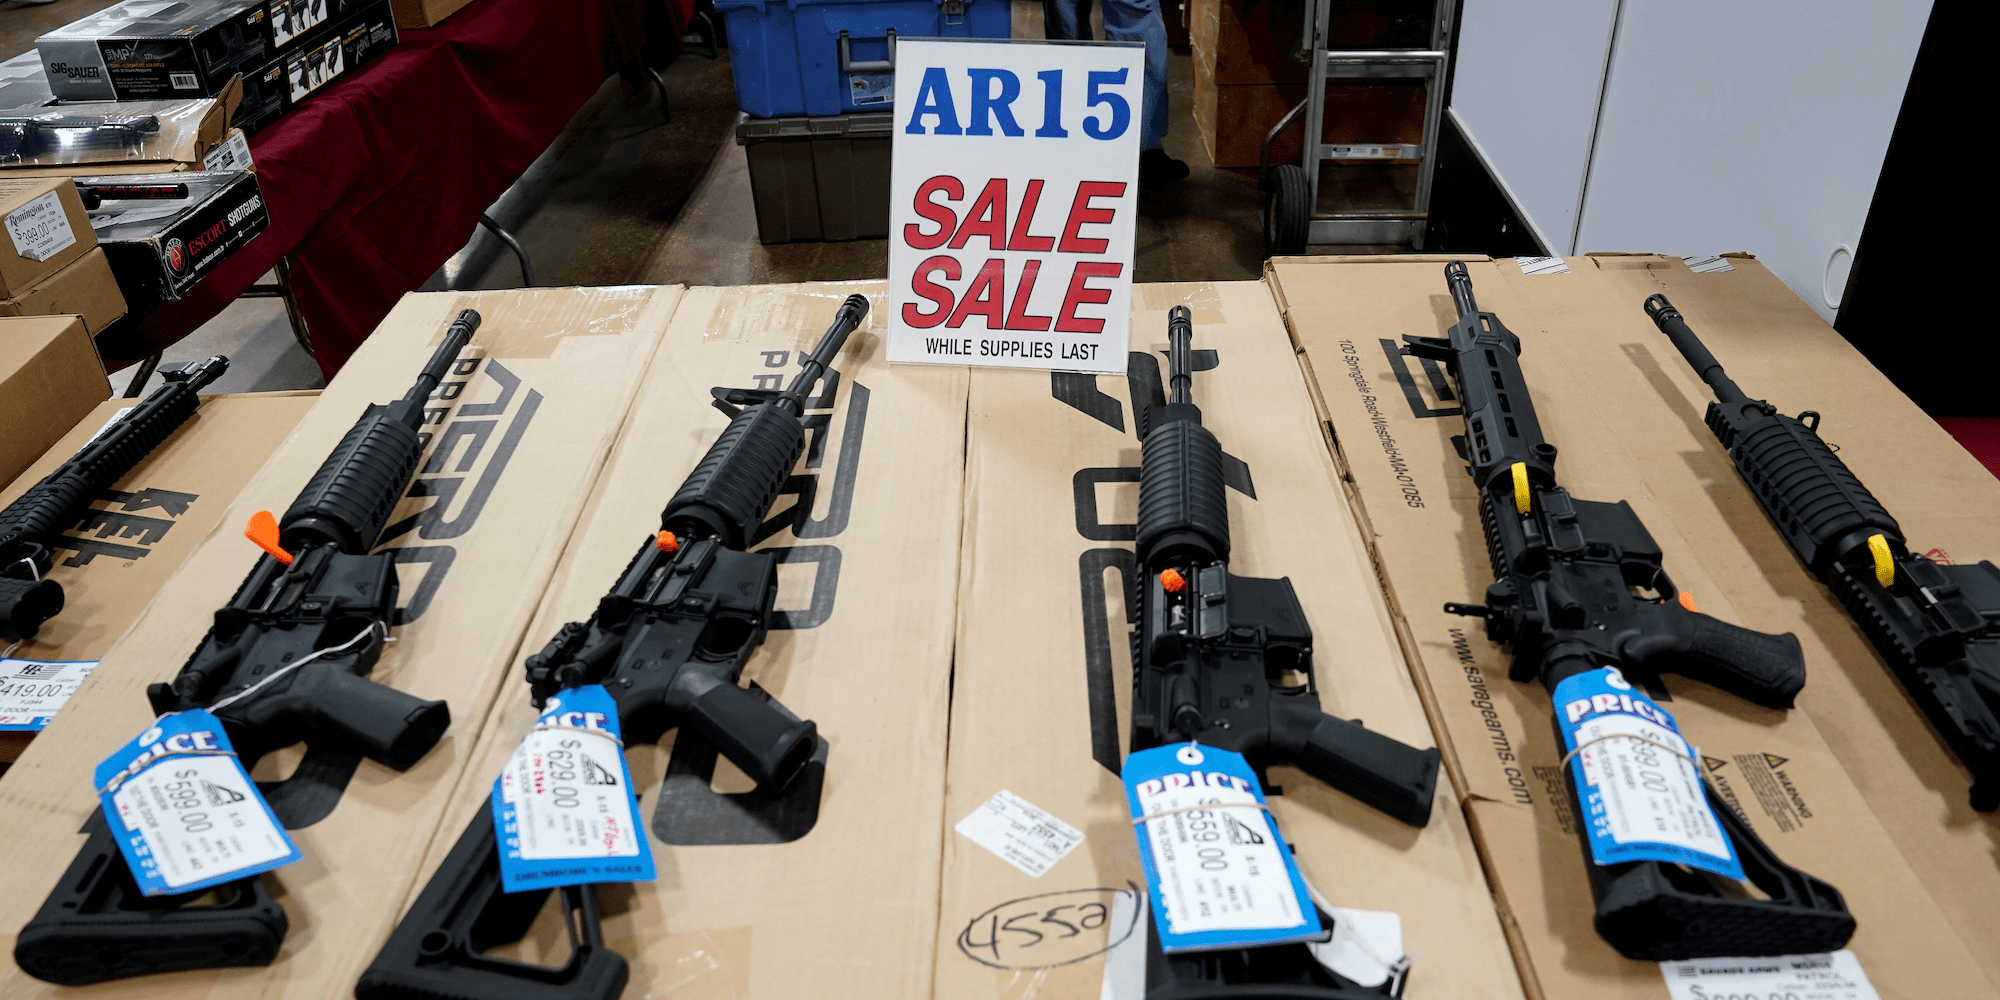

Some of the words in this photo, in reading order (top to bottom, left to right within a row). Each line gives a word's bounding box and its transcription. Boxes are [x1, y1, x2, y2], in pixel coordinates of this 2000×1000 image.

[51, 63, 67, 74] SIG
[68, 67, 99, 78] SAUER
[905, 67, 1131, 140] AR15
[10, 203, 45, 228] Remington
[188, 218, 227, 256] ESCORT
[226, 194, 261, 228] SHOTGUNS
[903, 175, 1127, 254] SALE
[901, 255, 1123, 334] SALE
[926, 338, 972, 356] WHILE
[980, 340, 1053, 358] SUPPLIES
[1061, 343, 1098, 360] LAST
[1338, 340, 1356, 356] 100
[1345, 352, 1370, 395] Springdale
[52, 487, 200, 568] KEL
[1448, 628, 1532, 805] www.savagearms.com
[1565, 693, 1675, 732] PRICE
[520, 773, 532, 794] DOOR
[1136, 770, 1254, 800] PRICE
[1775, 769, 1814, 819] WARNING
[140, 807, 159, 831] DOOR
[1161, 838, 1175, 862] DOOR
[1748, 966, 1781, 974] ARMS
